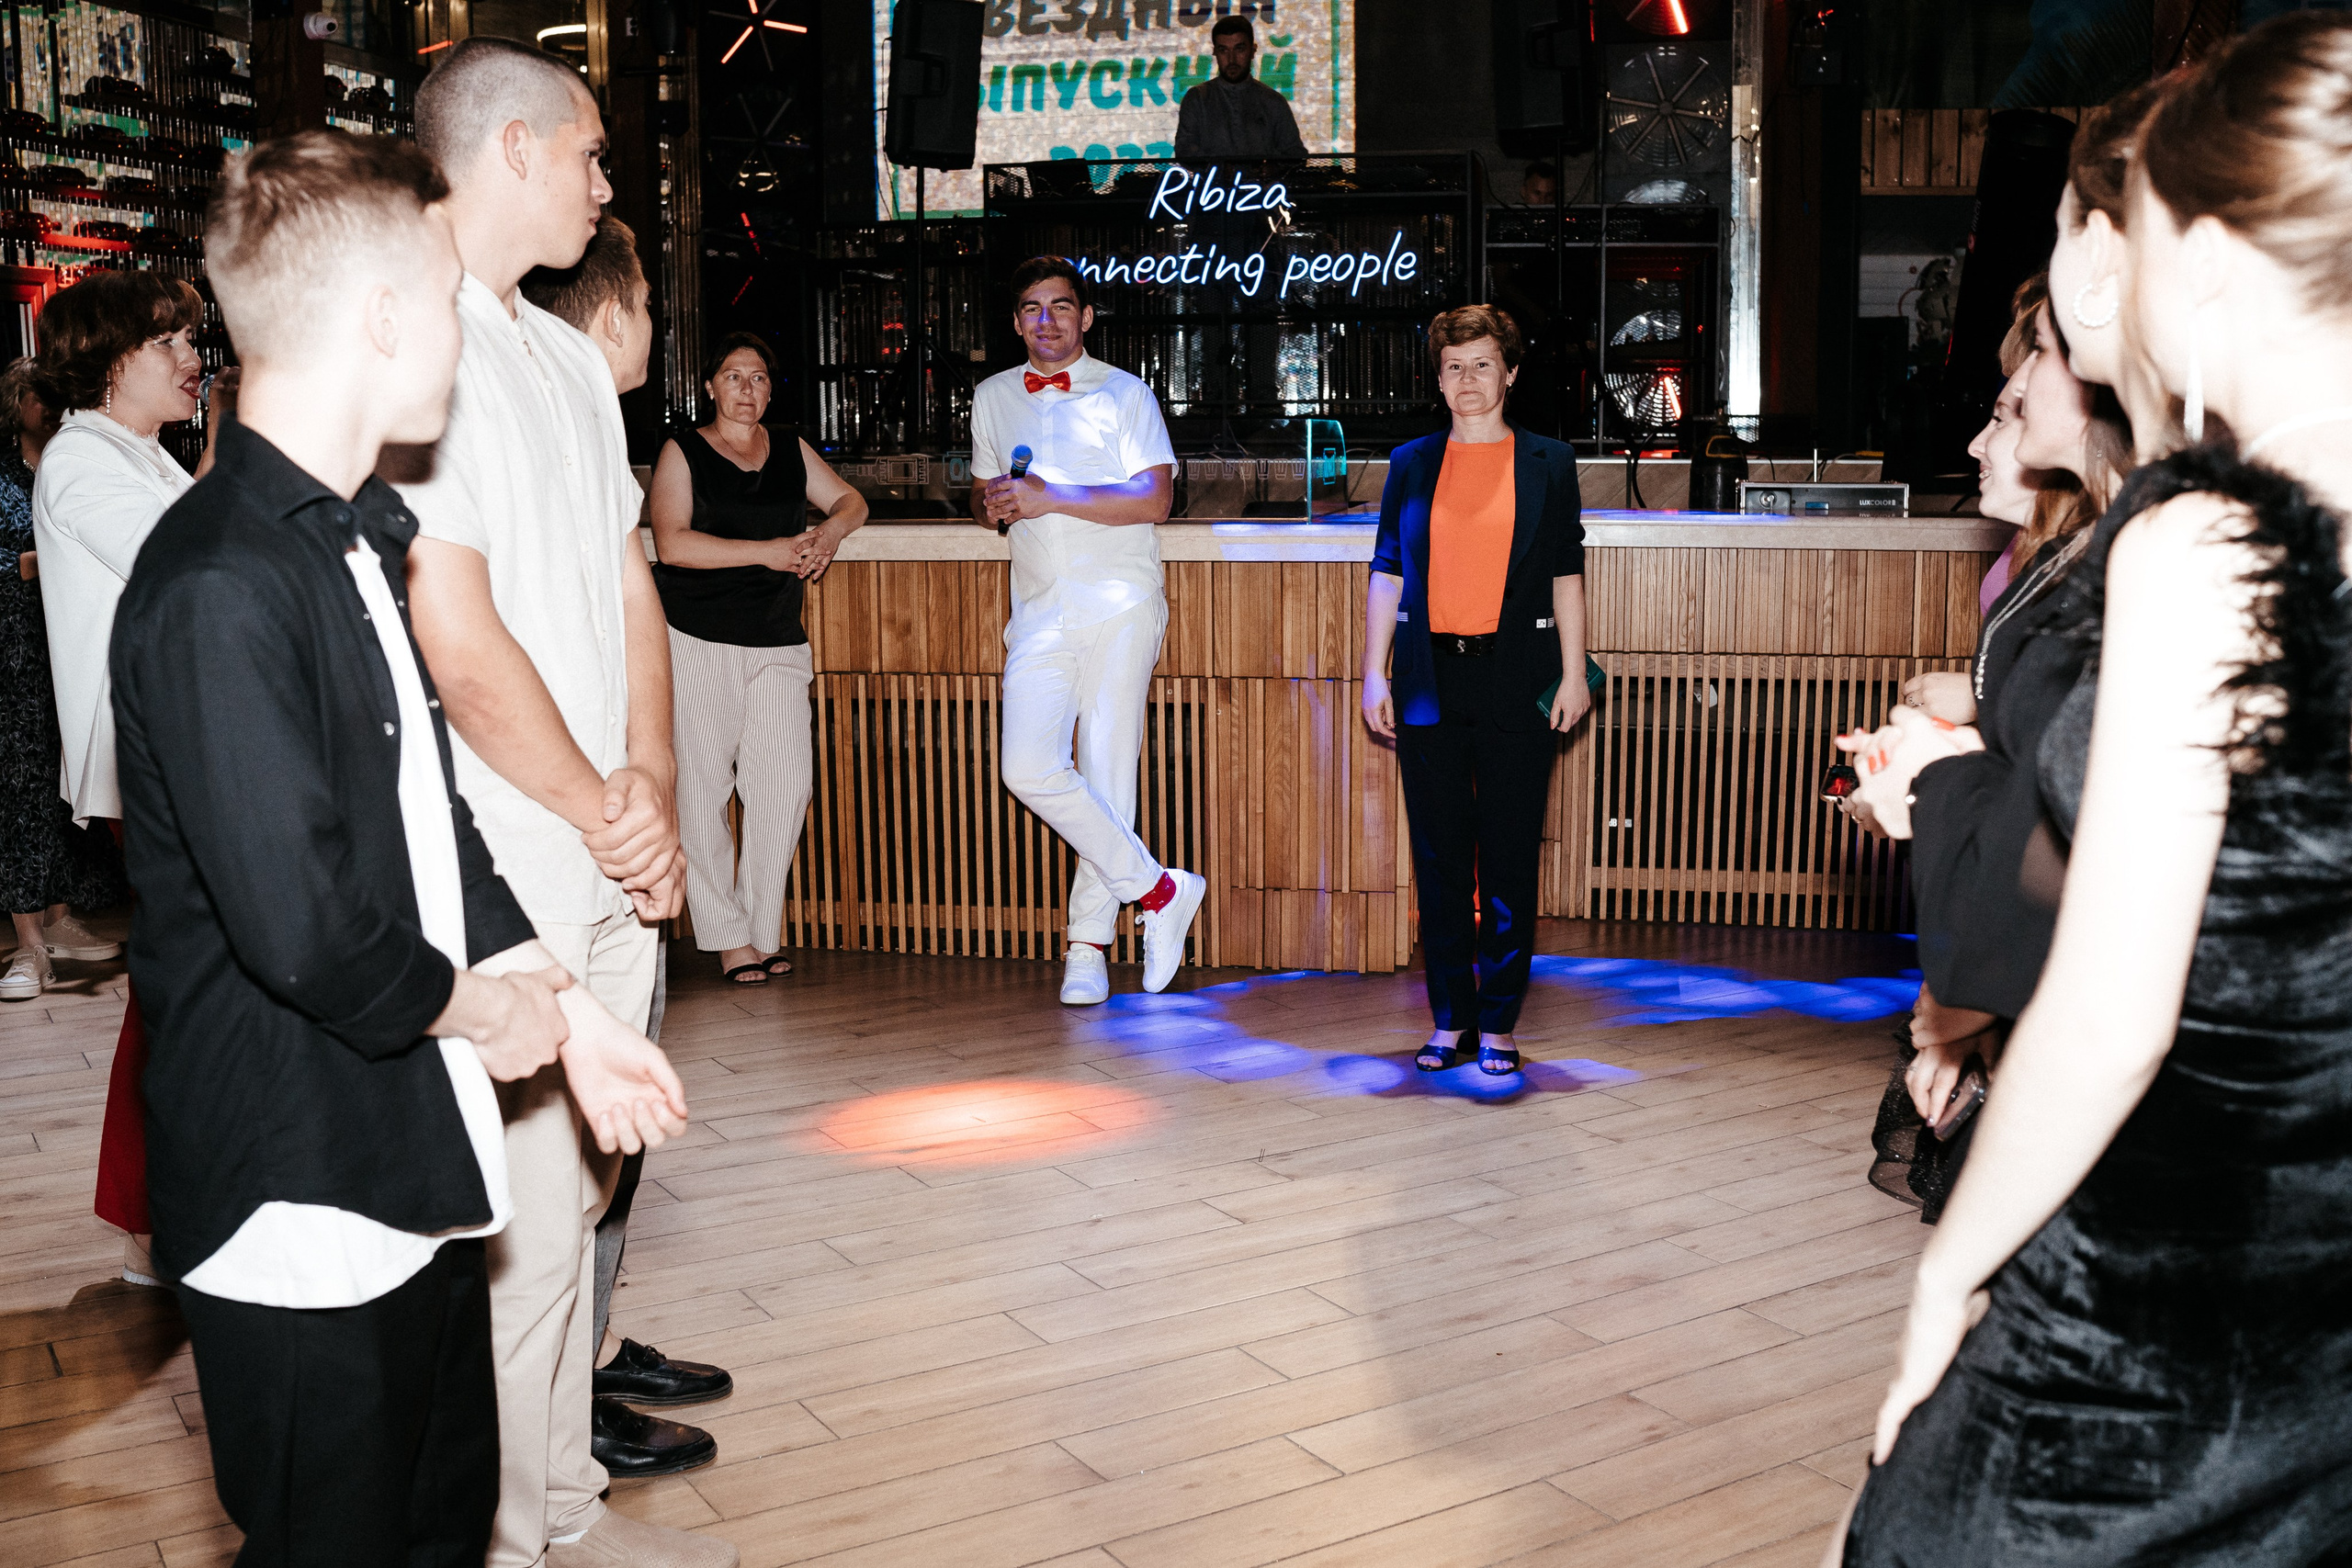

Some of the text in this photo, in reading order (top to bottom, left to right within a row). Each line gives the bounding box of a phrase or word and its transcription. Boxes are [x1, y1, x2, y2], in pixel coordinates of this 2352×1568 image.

[1149, 165, 1292, 220] Ribiza
[1064, 231, 1417, 299] nnecting people
